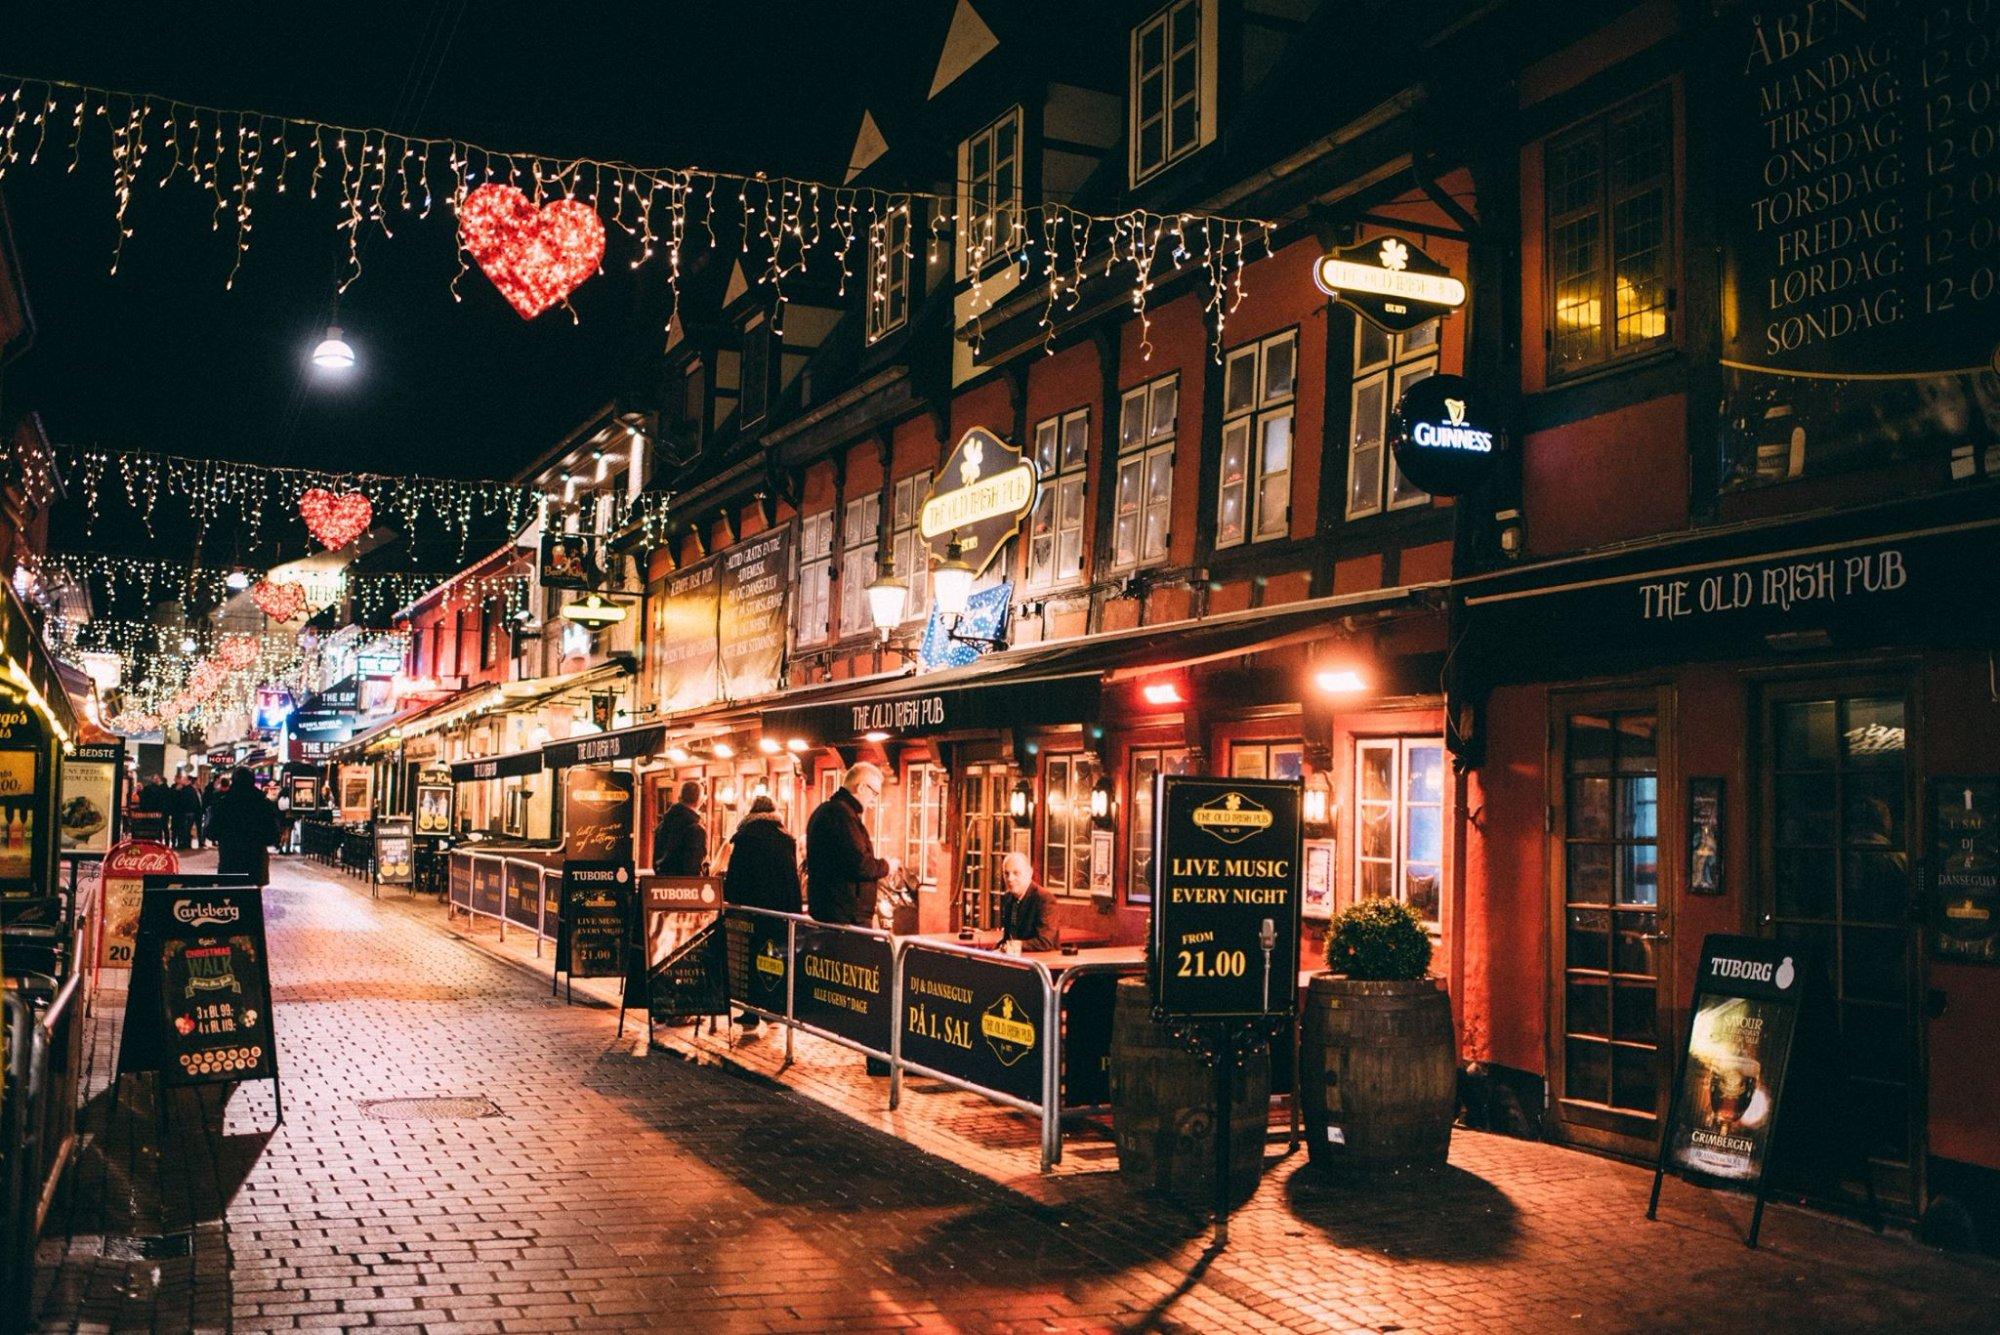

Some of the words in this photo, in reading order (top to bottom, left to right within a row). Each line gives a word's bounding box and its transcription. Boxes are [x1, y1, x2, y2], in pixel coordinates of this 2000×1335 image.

[1764, 72, 1900, 149] TIRSDAG:
[1764, 113, 1903, 187] ONSDAG:
[1751, 154, 1905, 231] TORSDAG:
[1778, 199, 1904, 266] FREDAG:
[1769, 242, 1904, 310] LØRDAG:
[1766, 289, 1904, 355] SØNDAG:
[1414, 422, 1493, 453] GUINNESS
[1639, 581, 1692, 621] THE
[1700, 571, 1753, 613] OLD
[1762, 560, 1835, 612] IRISH
[1846, 550, 1907, 595] PUB
[322, 692, 338, 702] THE
[852, 705, 870, 731] THE
[872, 702, 893, 729] OLD
[895, 699, 920, 732] IRISH
[921, 697, 944, 725] PUB
[80, 748, 115, 758] BEDSTE
[301, 742, 320, 753] THE
[572, 870, 614, 881] TUBORG
[1172, 858, 1219, 877] LIVE
[1225, 859, 1289, 878] MUSIC
[651, 888, 699, 900] TUBORG
[1172, 888, 1230, 904] EVERY
[1232, 889, 1287, 905] NIGHT
[173, 898, 239, 927] Carlsberg
[1181, 931, 1214, 945] FROM
[805, 954, 840, 983] GRATIS
[844, 966, 880, 994] ENTRÉ
[1177, 950, 1246, 978] 21.00
[1711, 957, 1773, 983] TUBORG
[910, 976, 920, 995] DJ
[920, 979, 926, 992] &
[927, 981, 974, 1004] DANSEGULV
[909, 1003, 927, 1036] PÅ
[930, 1013, 941, 1040] 1.
[945, 1016, 973, 1050] SAL
[1691, 1130, 1753, 1152] GRIMBERGEN
